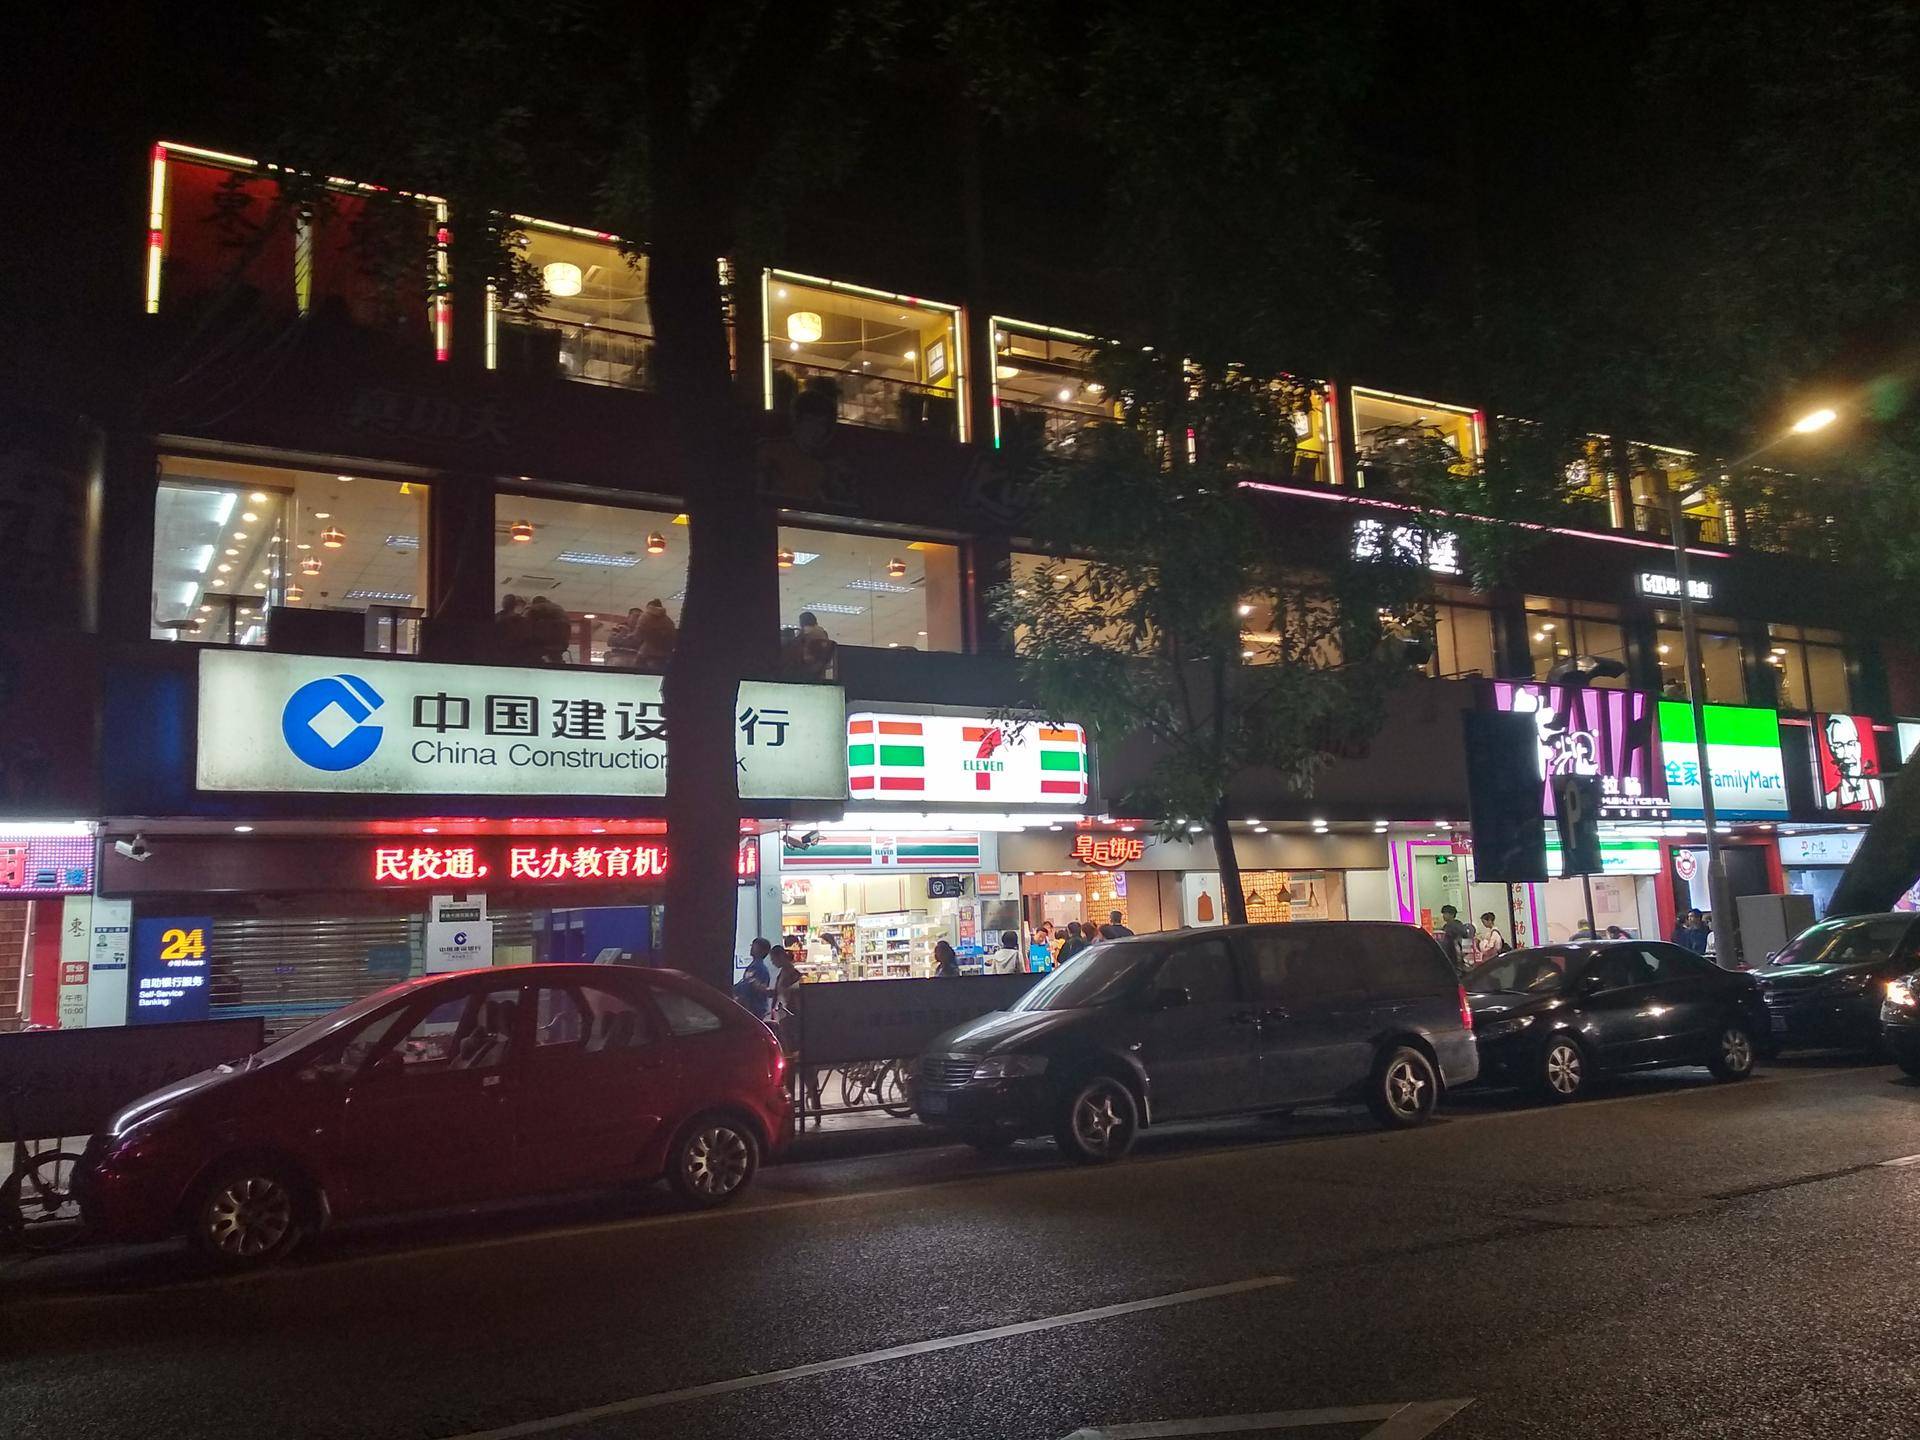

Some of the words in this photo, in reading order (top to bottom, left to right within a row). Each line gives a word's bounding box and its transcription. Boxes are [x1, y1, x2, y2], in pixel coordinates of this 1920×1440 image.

[411, 740, 498, 766] China
[962, 726, 1002, 790] 7
[1665, 760, 1700, 787] 全家
[1071, 835, 1145, 862] 皇后饼店
[160, 928, 206, 960] 24
[138, 990, 184, 999] Self-Service
[140, 976, 204, 989] 自助银行服务
[138, 999, 171, 1007] Banking
